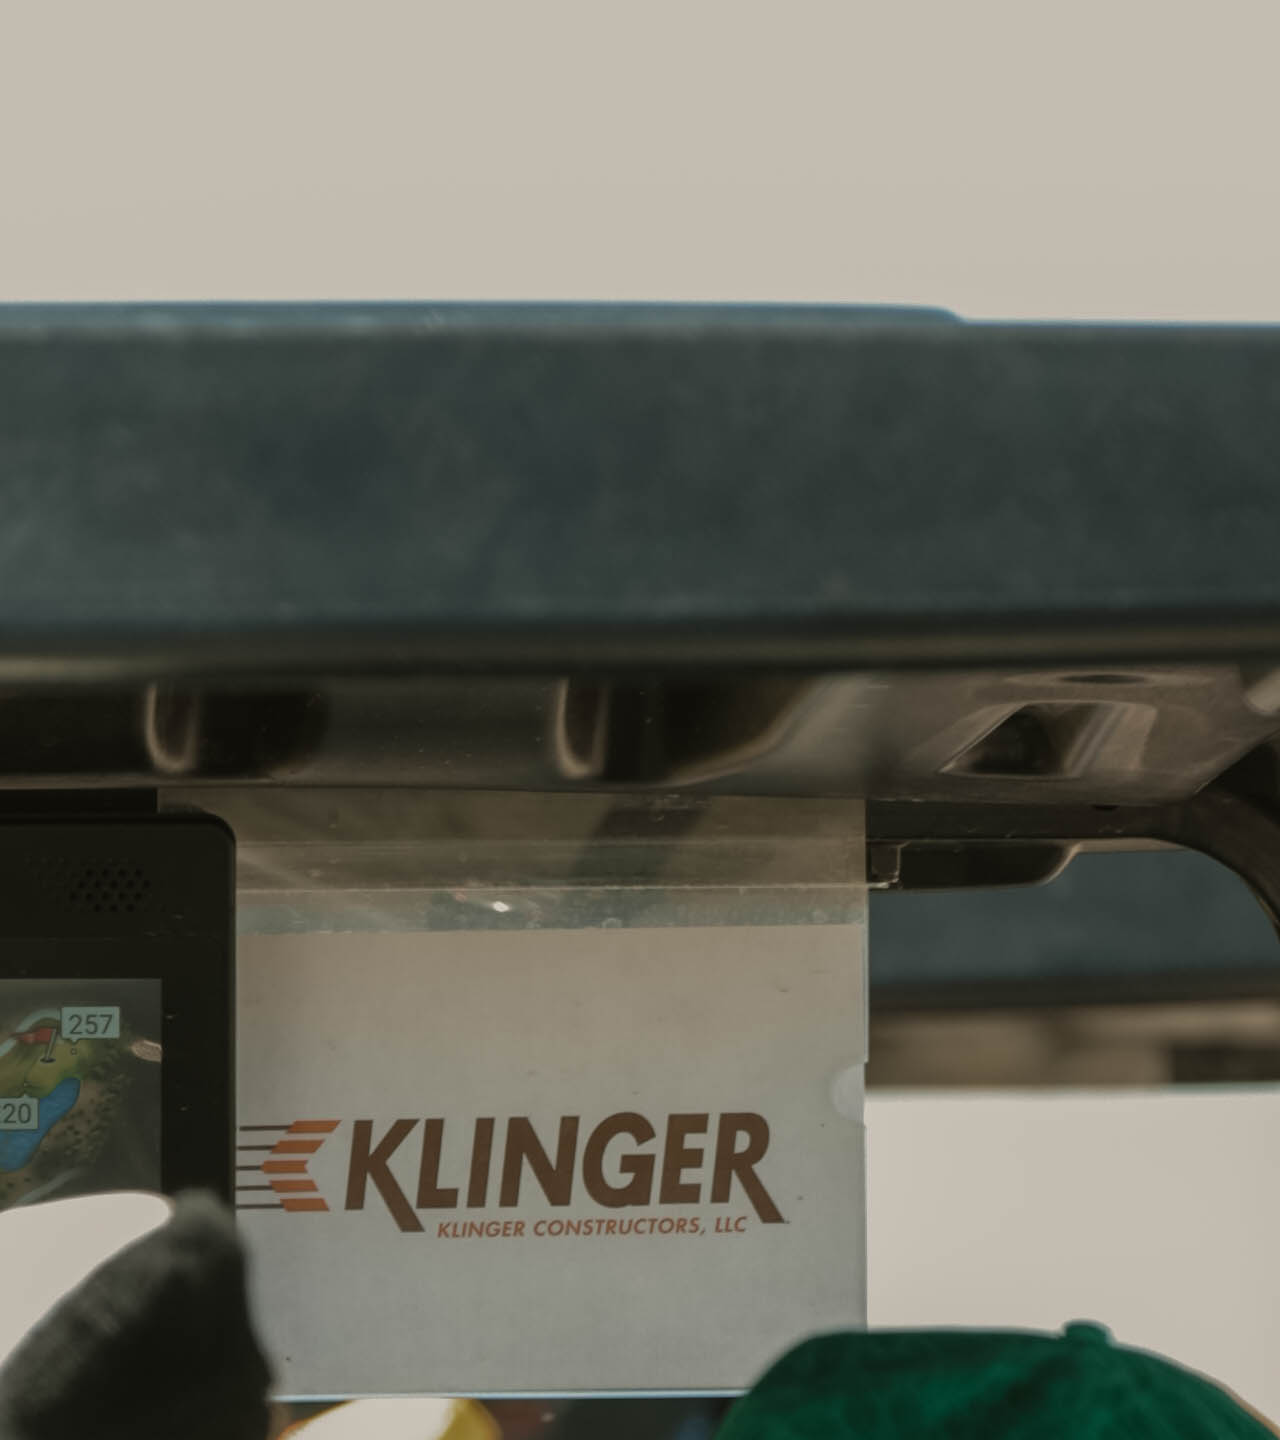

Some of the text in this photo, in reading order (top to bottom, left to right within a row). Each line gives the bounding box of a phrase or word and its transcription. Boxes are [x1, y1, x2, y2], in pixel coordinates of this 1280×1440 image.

[68, 1014, 114, 1036] 257
[344, 1111, 786, 1233] KLINGER
[437, 1216, 748, 1239] KLINGER CONSTRUCTORS, LLC
